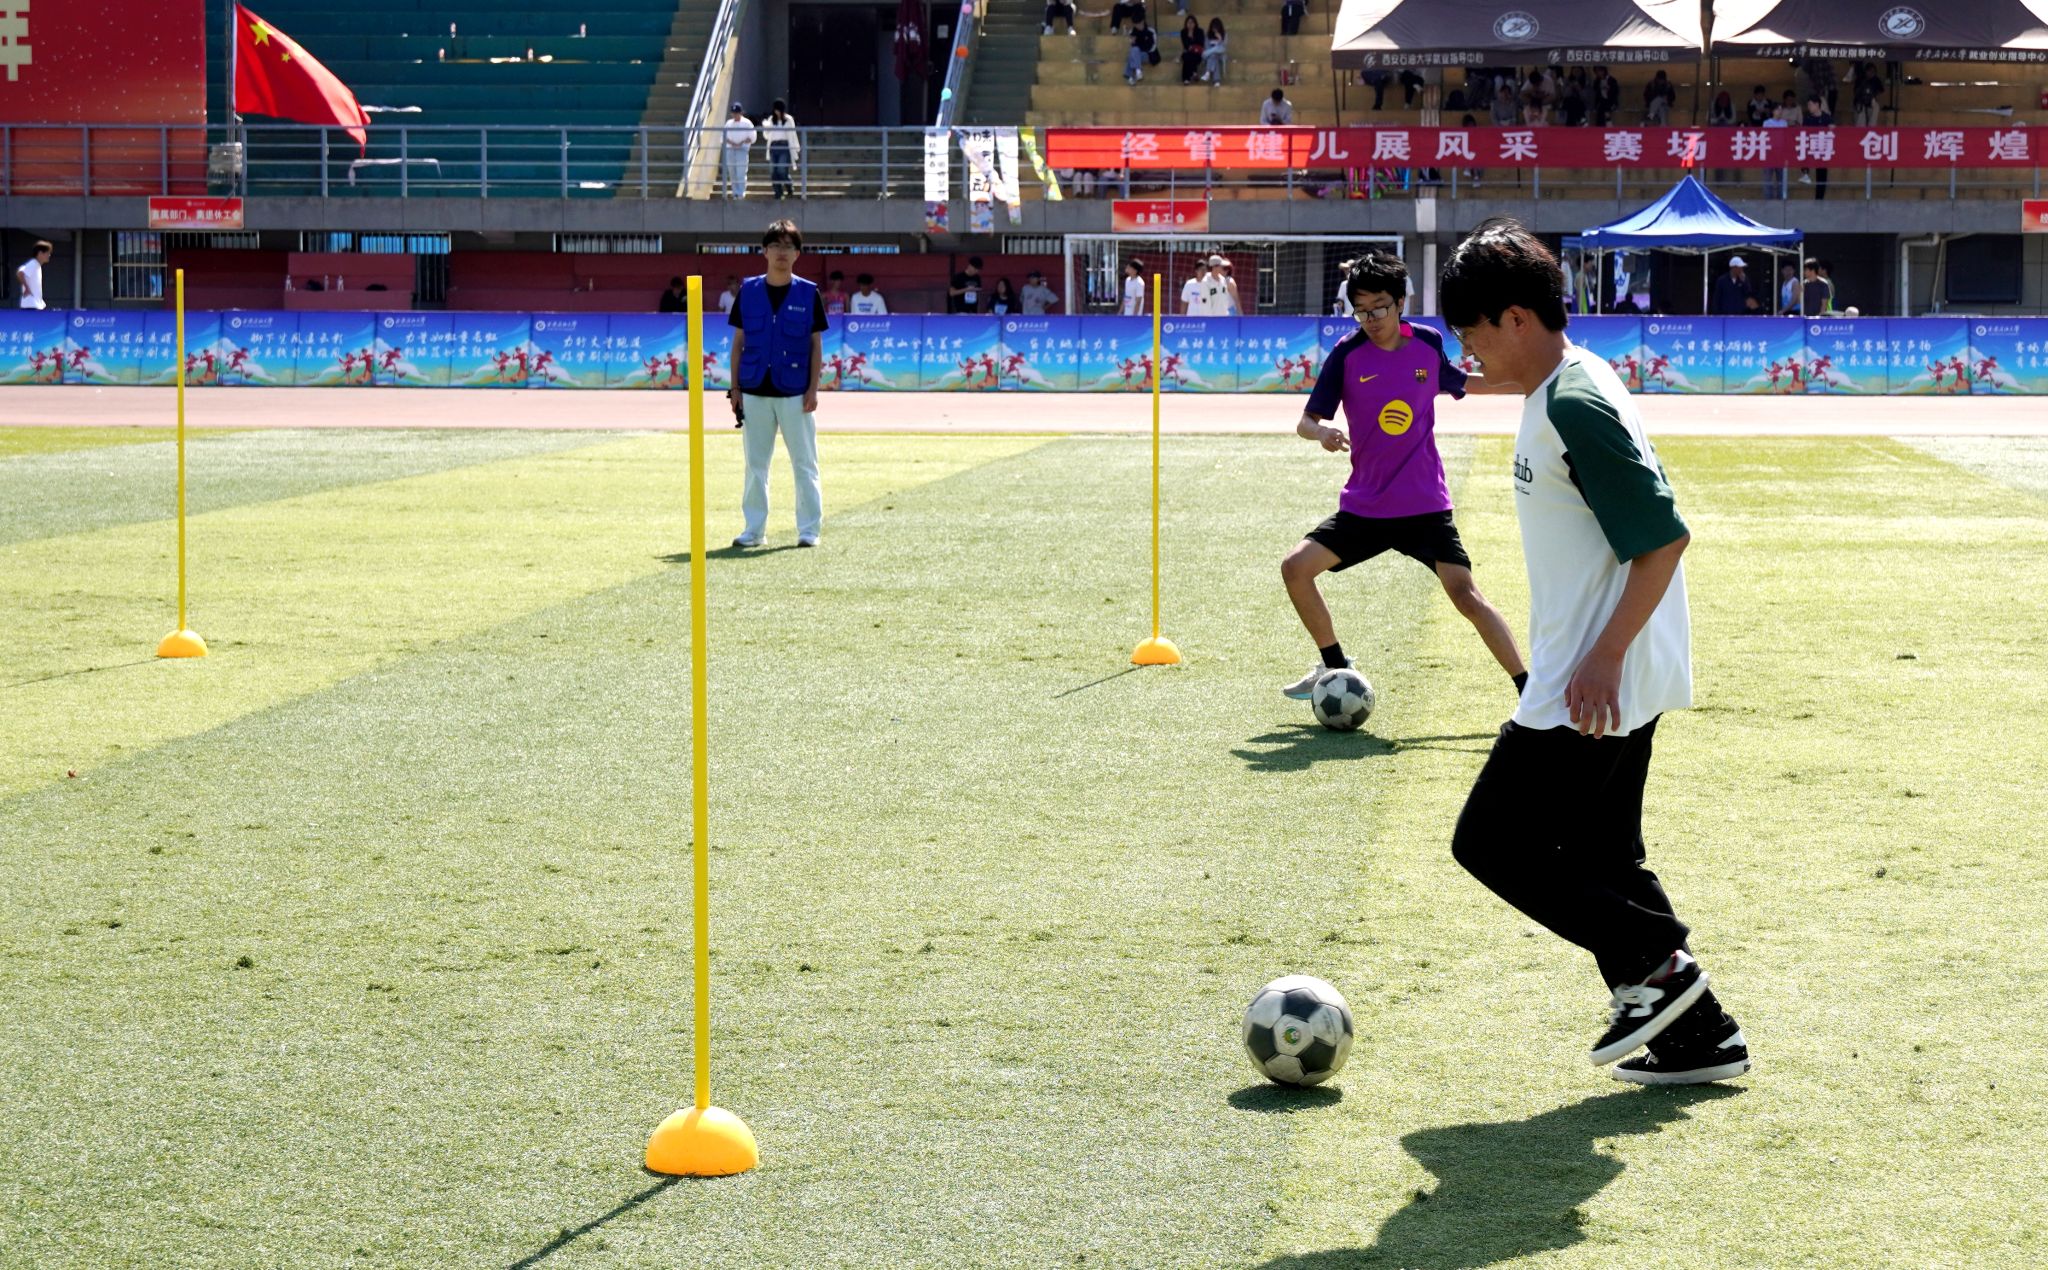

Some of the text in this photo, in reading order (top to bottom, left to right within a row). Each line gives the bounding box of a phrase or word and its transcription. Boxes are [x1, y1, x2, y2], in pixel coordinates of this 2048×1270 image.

[1382, 53, 1484, 65] 西安石油大学就业指导中心
[1566, 50, 1669, 63] 西安石油大学就业指导中心
[1120, 131, 2030, 161] 经管健儿展风采 赛场拼搏创辉煌
[151, 209, 241, 221] 直属部门、离退休工会
[1136, 212, 1185, 224] 后勤工会
[870, 336, 963, 350] 力拔山兮气盖世
[1671, 339, 1768, 353] 今日赛场砺锋芒
[1832, 339, 1931, 352] 趣味赛跑笑声扬
[1671, 354, 1768, 367] 明日人生创辉煌
